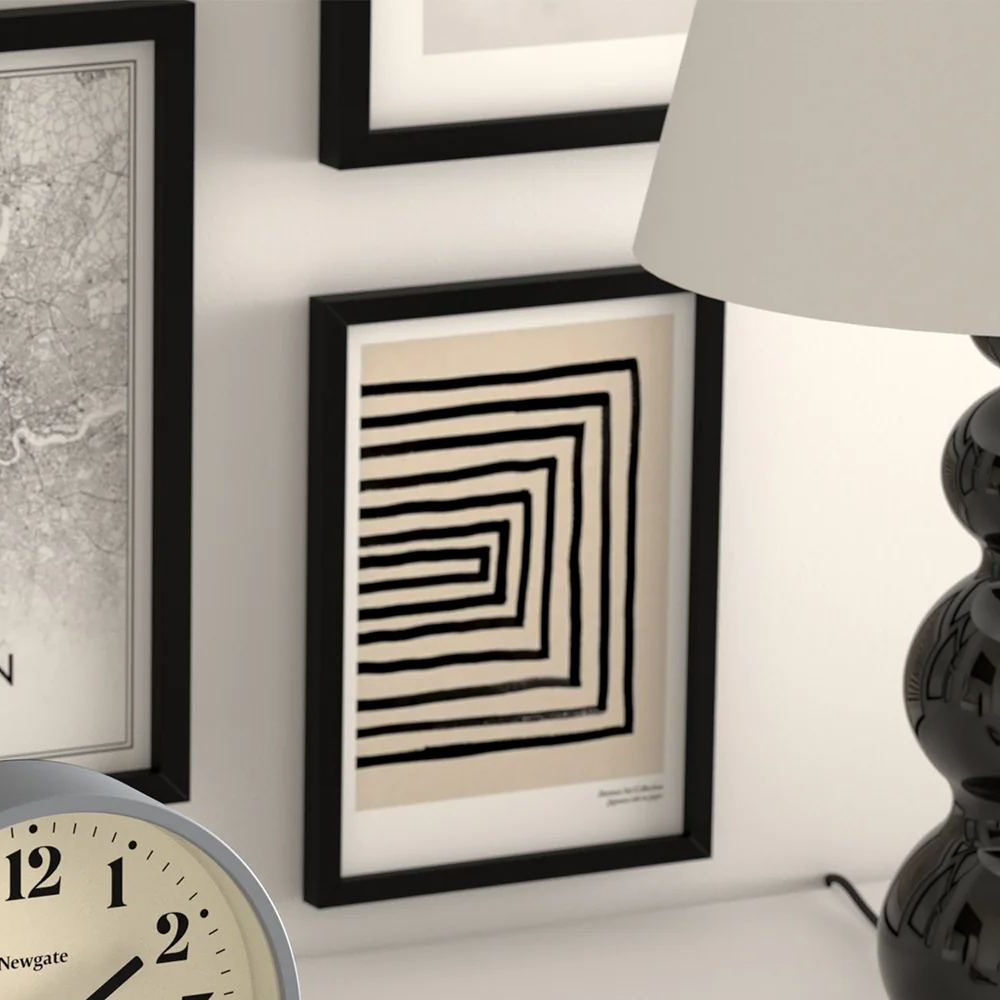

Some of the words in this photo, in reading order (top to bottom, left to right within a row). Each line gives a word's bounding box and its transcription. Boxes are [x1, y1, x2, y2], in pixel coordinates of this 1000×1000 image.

[5, 845, 62, 902] 12
[106, 856, 127, 909] 1
[155, 911, 190, 965] 2
